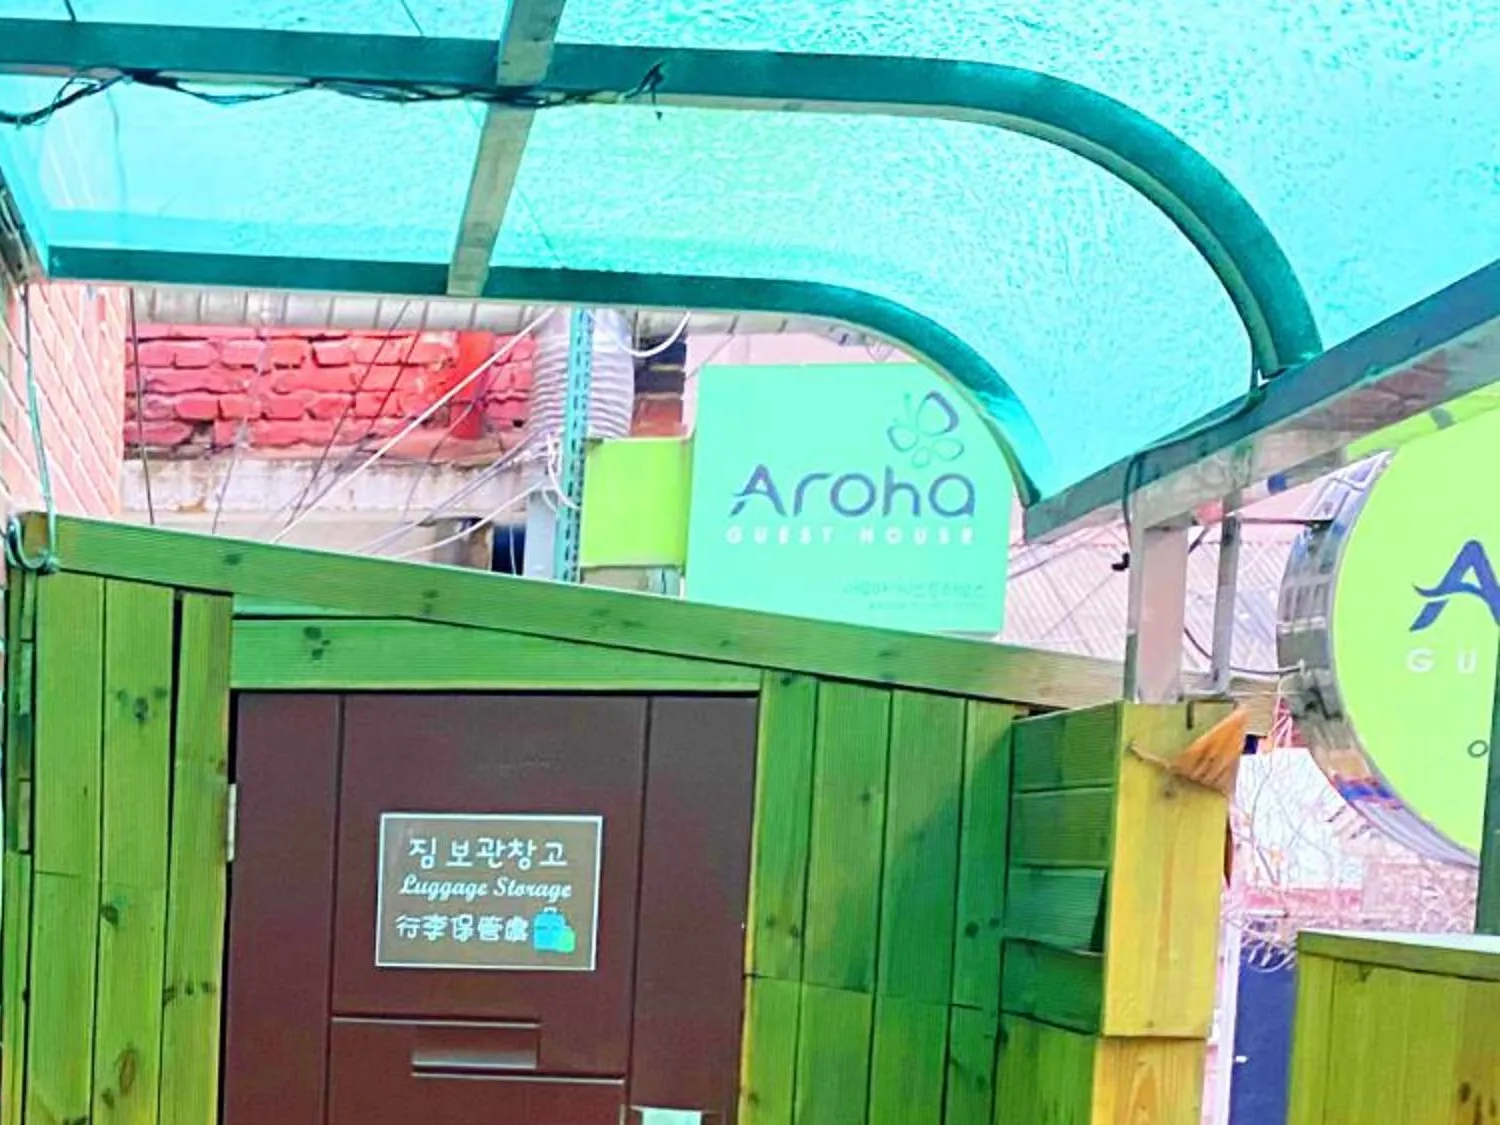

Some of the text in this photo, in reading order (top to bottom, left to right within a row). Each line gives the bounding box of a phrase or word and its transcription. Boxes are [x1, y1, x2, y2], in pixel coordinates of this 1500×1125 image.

[729, 464, 976, 517] Aroha
[725, 525, 975, 545] GUEST HOUSE
[399, 874, 572, 903] Luggage Storage
